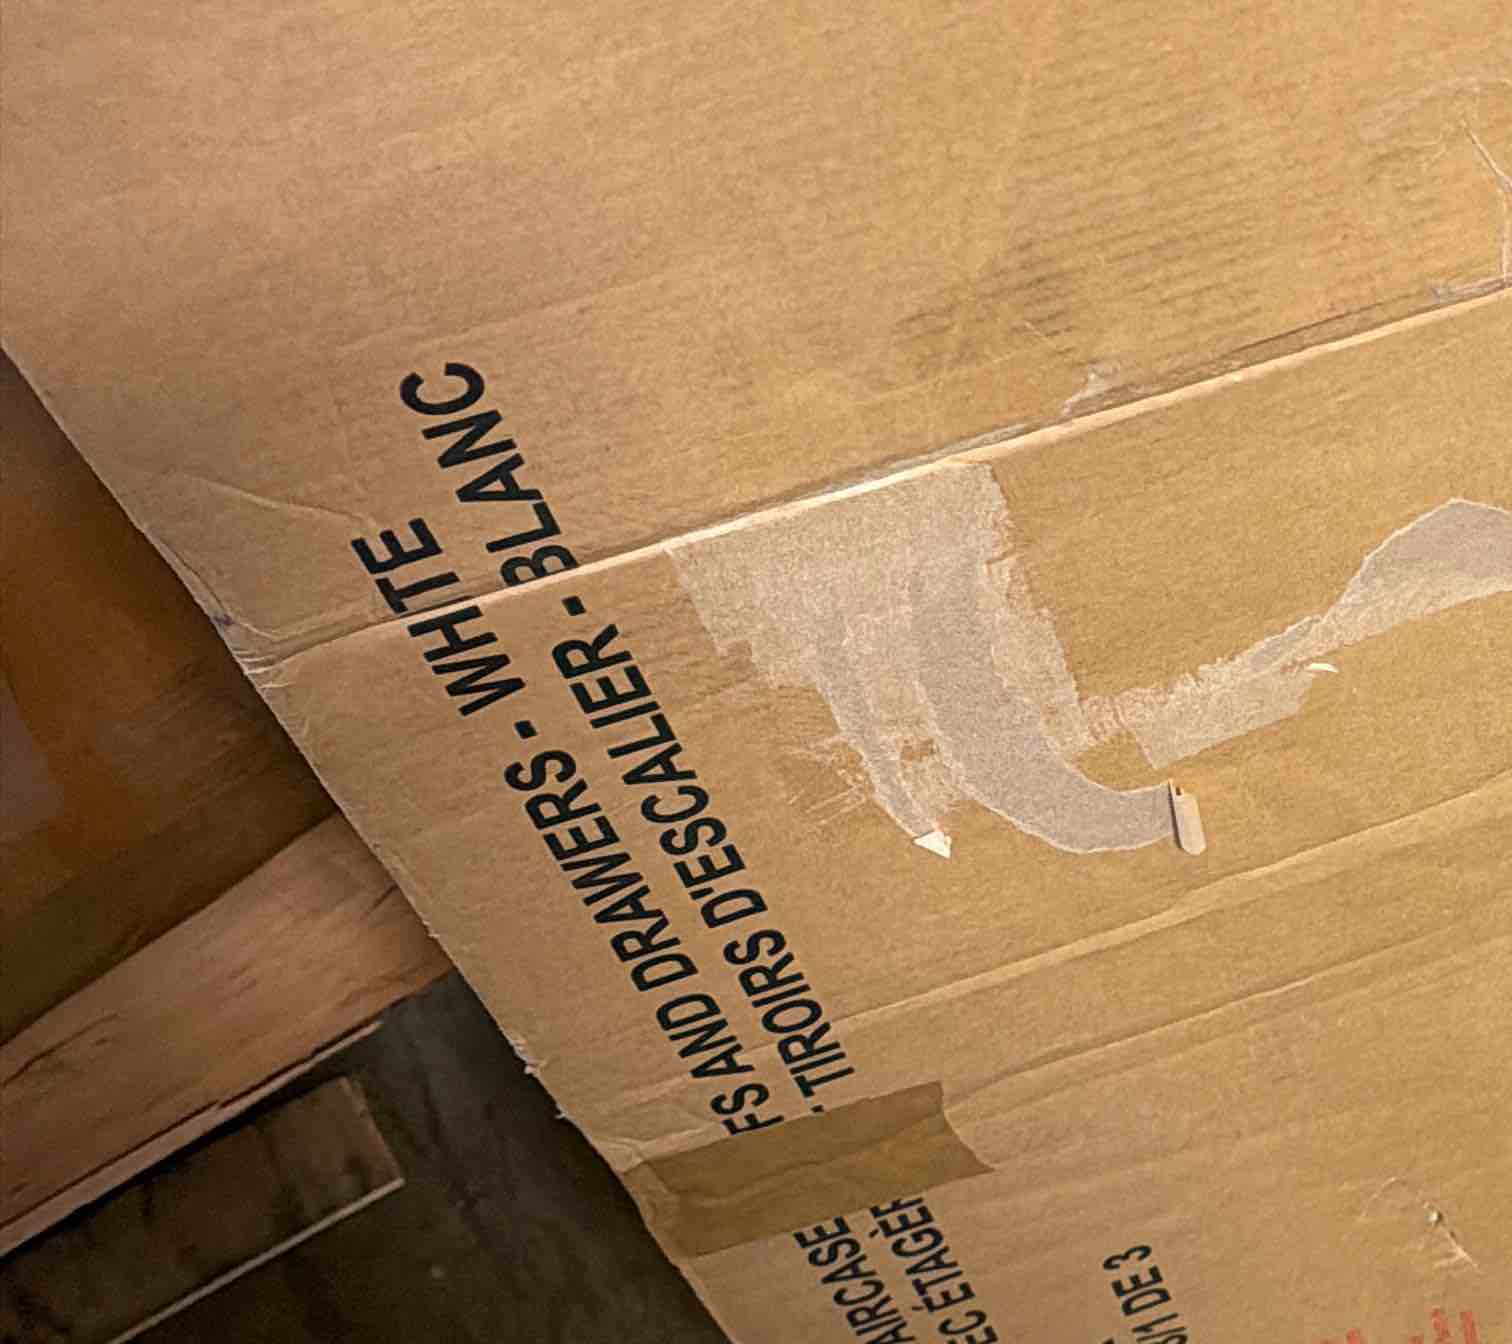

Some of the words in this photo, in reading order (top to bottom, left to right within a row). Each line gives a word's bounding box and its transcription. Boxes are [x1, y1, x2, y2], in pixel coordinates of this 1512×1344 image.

[401, 363, 581, 587] BLANC
[552, 624, 768, 928] D'ESCALIER
[504, 750, 698, 991] DRAWERS
[656, 993, 754, 1078] AND
[724, 930, 854, 1097] TIROIRS
[1103, 1245, 1152, 1270] 3
[1112, 1266, 1171, 1316] DE
